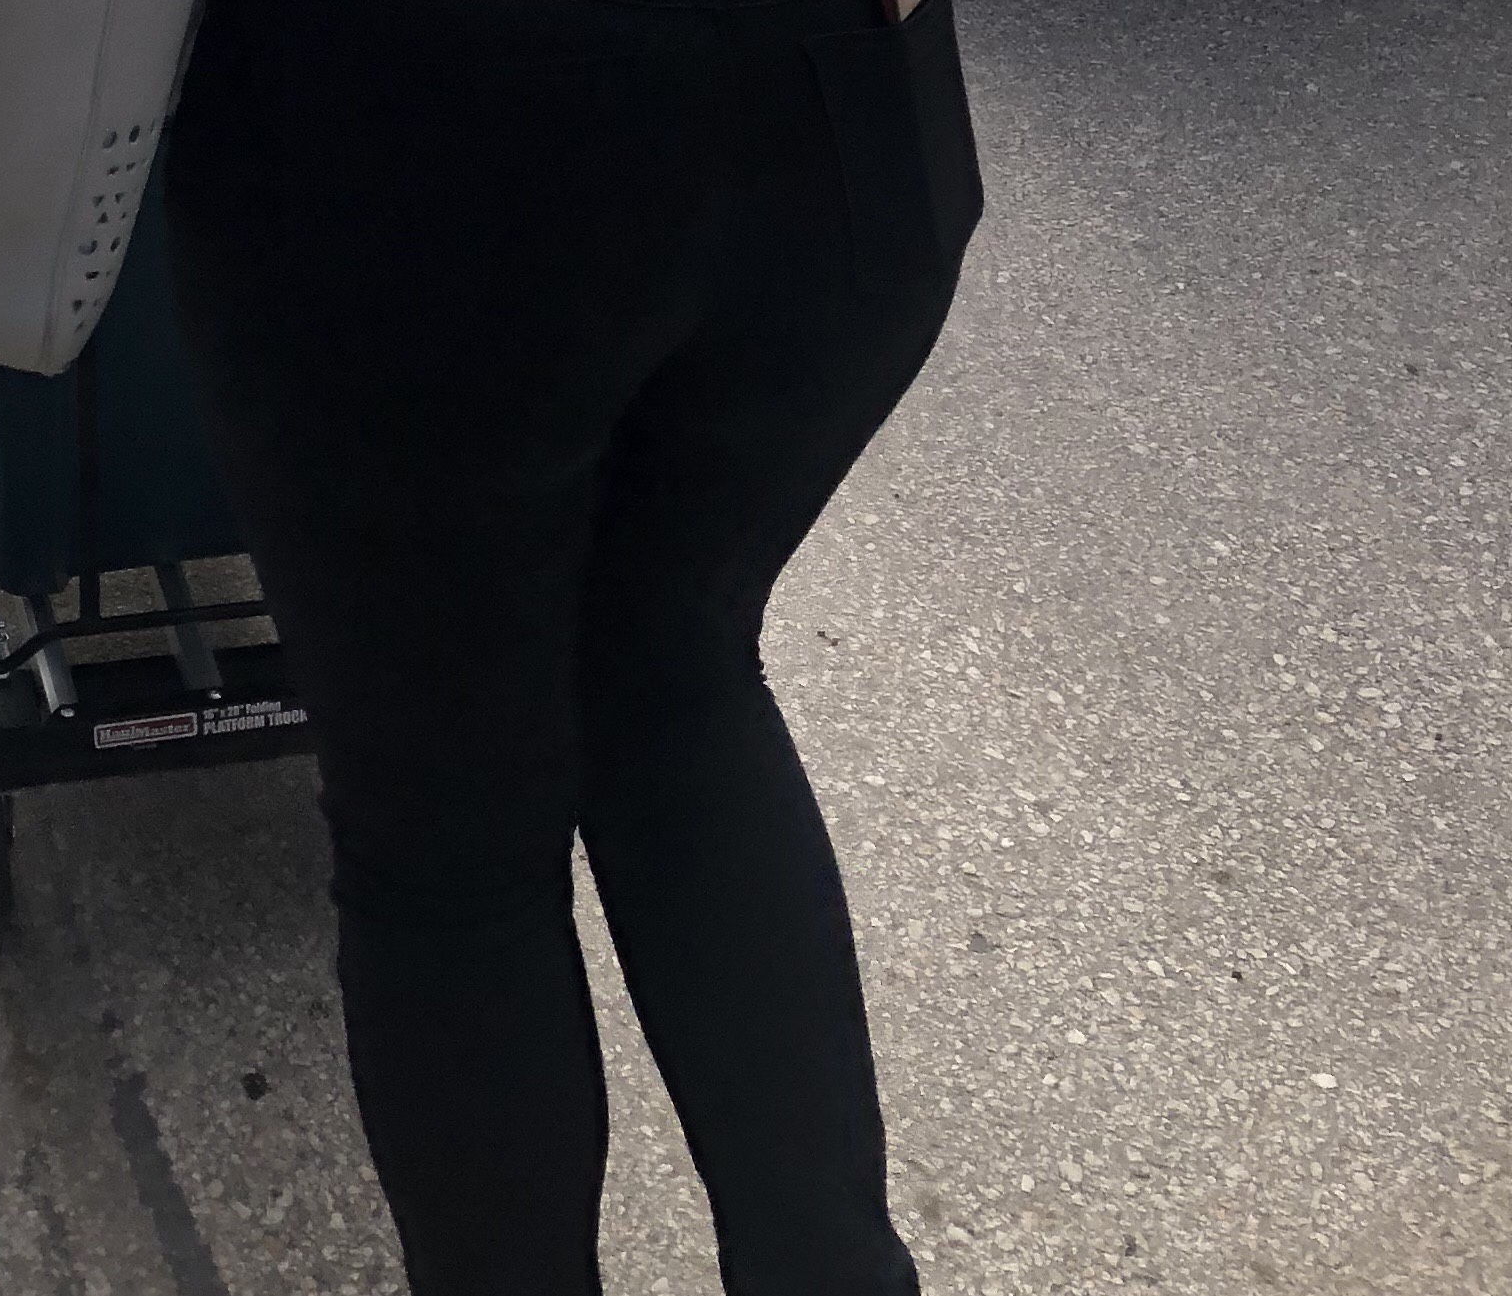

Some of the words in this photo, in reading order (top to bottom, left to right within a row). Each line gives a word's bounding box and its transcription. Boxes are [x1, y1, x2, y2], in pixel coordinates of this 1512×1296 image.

[245, 701, 281, 714] Folding
[202, 714, 266, 736] PLATFORM
[267, 708, 308, 727] TRUCK
